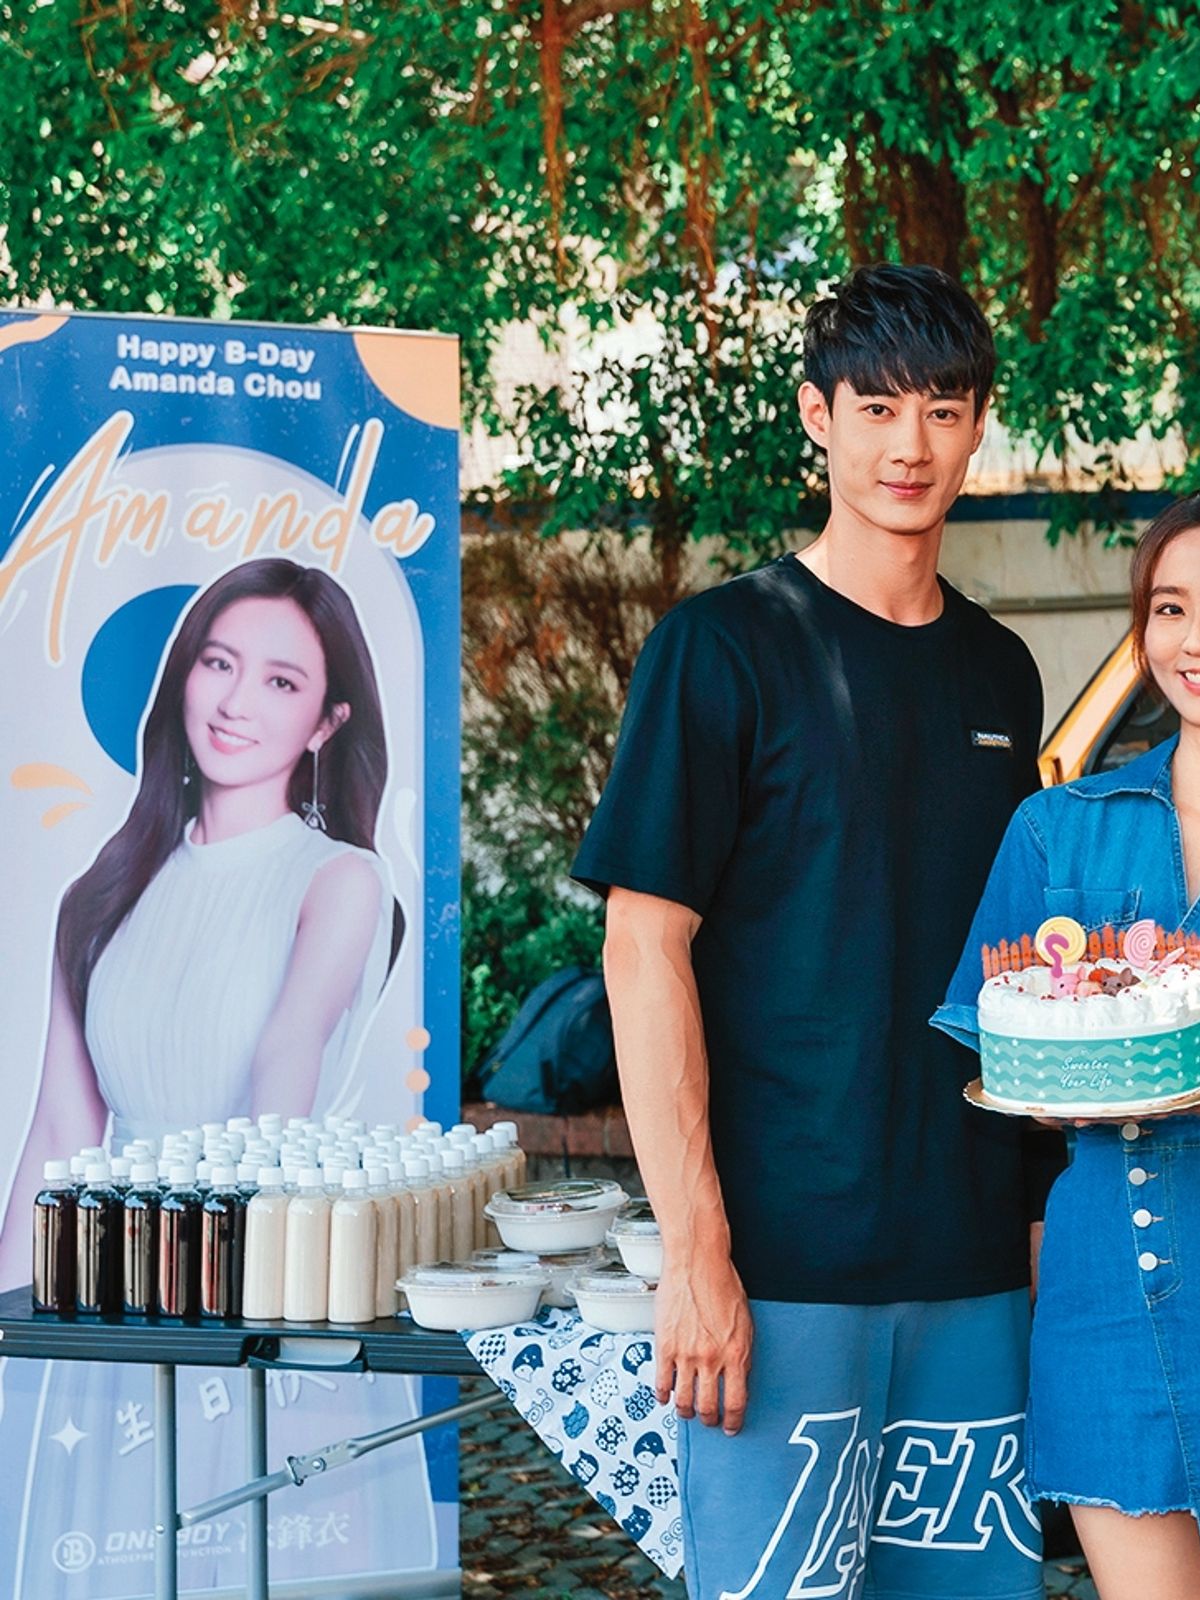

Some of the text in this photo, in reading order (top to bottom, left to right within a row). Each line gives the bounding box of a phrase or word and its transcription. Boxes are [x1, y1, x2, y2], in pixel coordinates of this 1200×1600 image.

[117, 333, 315, 374] Happy B-Day
[109, 365, 322, 400] Amanda Chou
[0, 410, 435, 665] Amanda
[1061, 1056, 1110, 1071] Sweeten
[1060, 1072, 1113, 1091] Your Life
